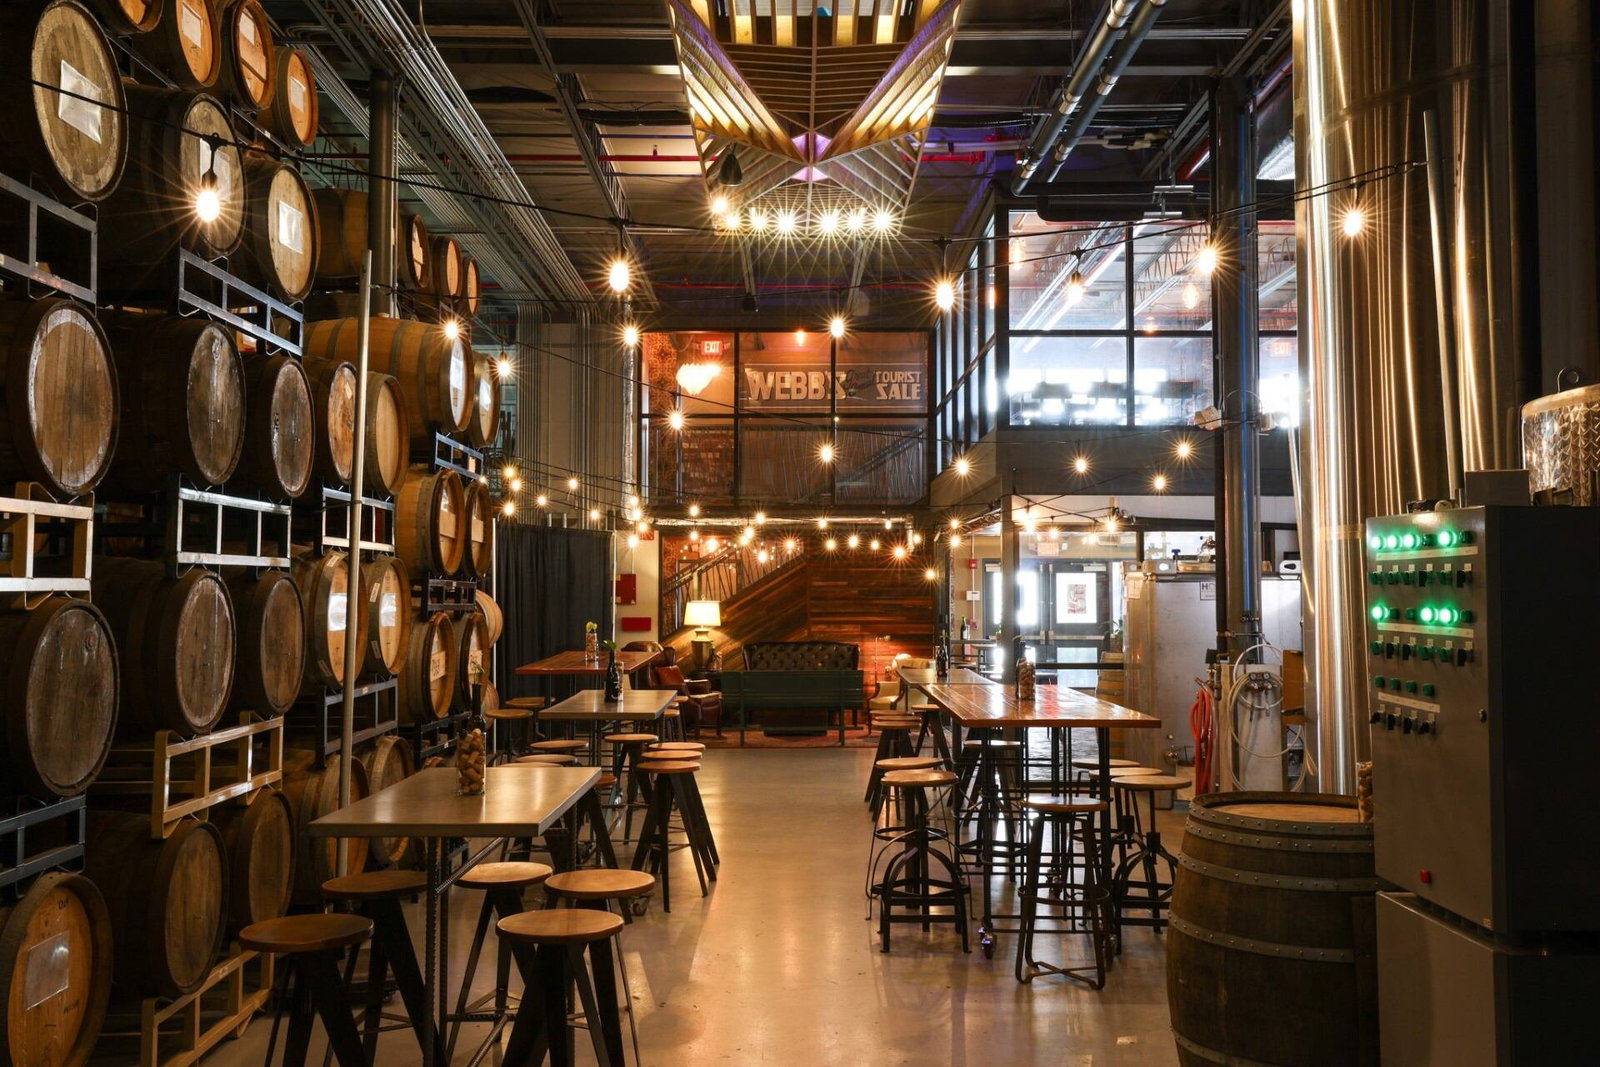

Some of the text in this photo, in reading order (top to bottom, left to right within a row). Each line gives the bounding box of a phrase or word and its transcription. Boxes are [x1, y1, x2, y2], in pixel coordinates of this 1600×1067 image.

[704, 341, 721, 354] EXIT
[1274, 343, 1289, 354] EXIT
[875, 371, 921, 383] TOURIST
[876, 383, 921, 400] SALE
